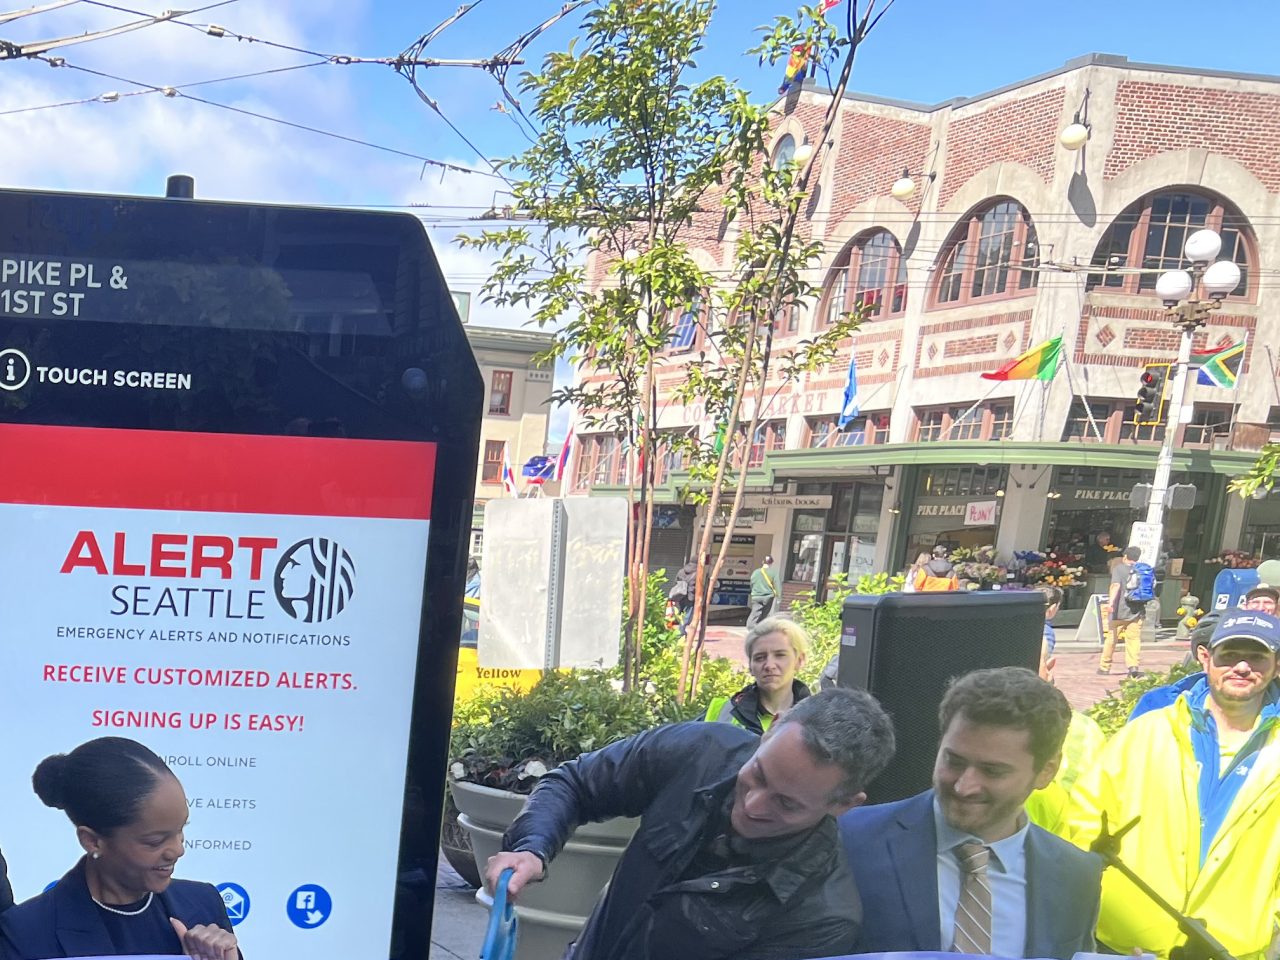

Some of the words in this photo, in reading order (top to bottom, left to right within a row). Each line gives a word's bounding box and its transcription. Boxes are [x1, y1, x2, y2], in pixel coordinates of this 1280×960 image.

[2, 259, 62, 287] PIKE
[68, 262, 102, 289] PL
[109, 265, 129, 290] &
[1, 289, 46, 315] 1ST
[51, 292, 85, 317] ST
[36, 366, 107, 387] TOUCH
[113, 369, 192, 390] SCREEN
[1075, 489, 1101, 499] PIKE
[917, 505, 938, 516] PIKE
[59, 530, 278, 582] ALERT
[109, 584, 267, 620] SEATTLE
[56, 626, 145, 641] EMERGENCY
[149, 629, 204, 643] ALERTS
[207, 631, 239, 644] AND
[243, 632, 351, 647] NOTIFICATIONS
[43, 664, 128, 685] RECEIVE
[133, 667, 271, 689] CUSTOMIZED
[276, 672, 358, 691] ALERTS.
[476, 667, 521, 679] Yellow
[91, 710, 182, 730] SIGNING
[189, 713, 218, 731] UP
[223, 713, 242, 731] IS
[248, 715, 305, 733] EASY!
[164, 755, 202, 766] ROLL
[206, 756, 257, 768] ONLINE
[206, 798, 257, 810] ALERTS
[184, 839, 252, 851] NFORMED
